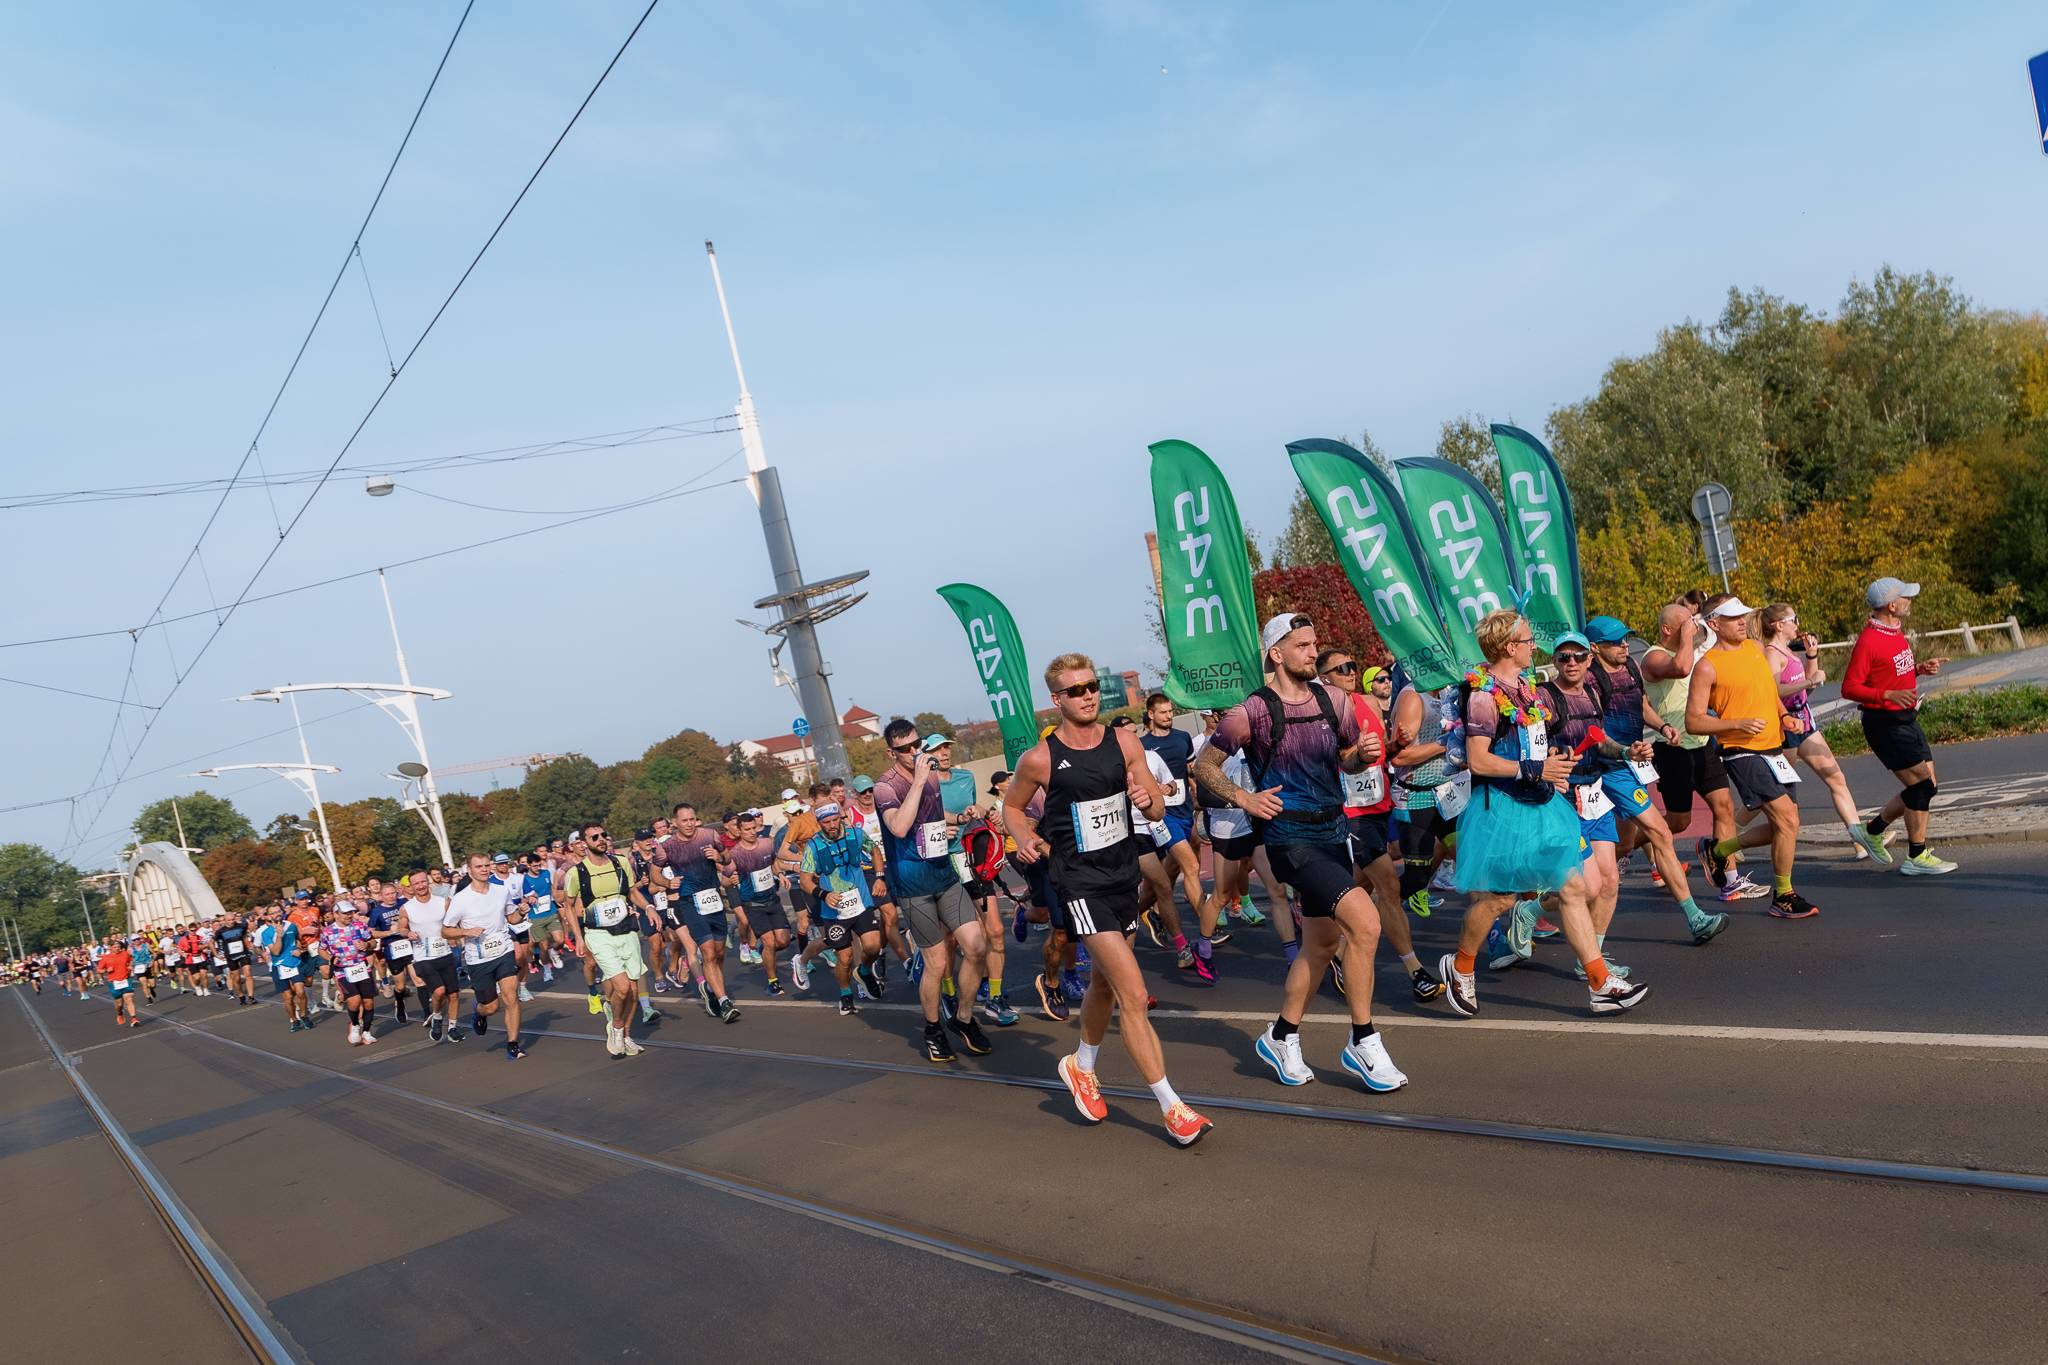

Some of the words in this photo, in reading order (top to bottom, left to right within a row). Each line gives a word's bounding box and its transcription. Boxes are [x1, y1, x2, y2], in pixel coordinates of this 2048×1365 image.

[1356, 778, 1377, 792] 241
[1091, 809, 1119, 830] 3711
[930, 832, 947, 843] 428
[1098, 827, 1118, 838] Szymon
[702, 895, 719, 905] 4052
[840, 897, 858, 909] 2939
[484, 940, 503, 950] 5226
